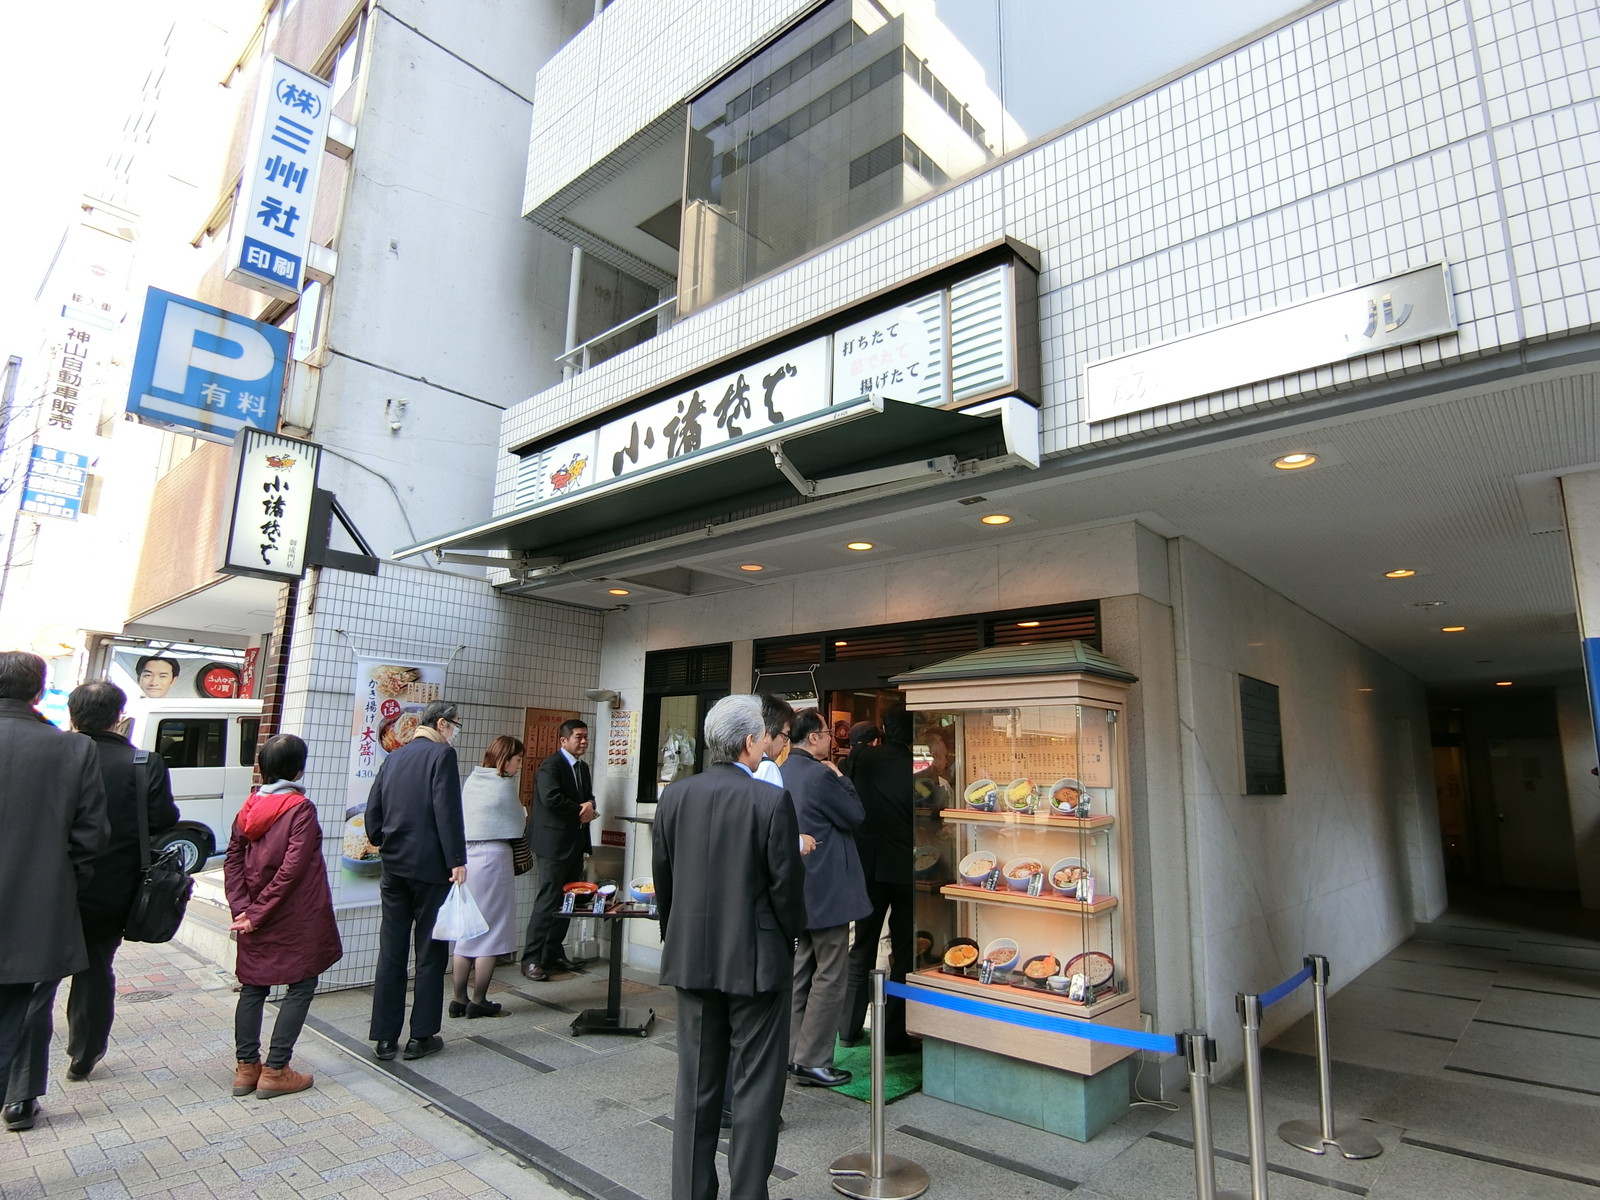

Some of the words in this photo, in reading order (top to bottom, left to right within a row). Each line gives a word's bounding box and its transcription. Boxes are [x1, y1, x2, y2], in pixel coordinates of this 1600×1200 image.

[247, 246, 295, 280] 印刷
[151, 300, 275, 395] P
[842, 322, 899, 357] 打ちたて
[48, 327, 91, 431] 神山自動車販売
[860, 361, 920, 395] 揚げたて
[201, 382, 266, 418] 有料
[365, 678, 379, 724] かき揚げ
[358, 726, 377, 767] 大盛り
